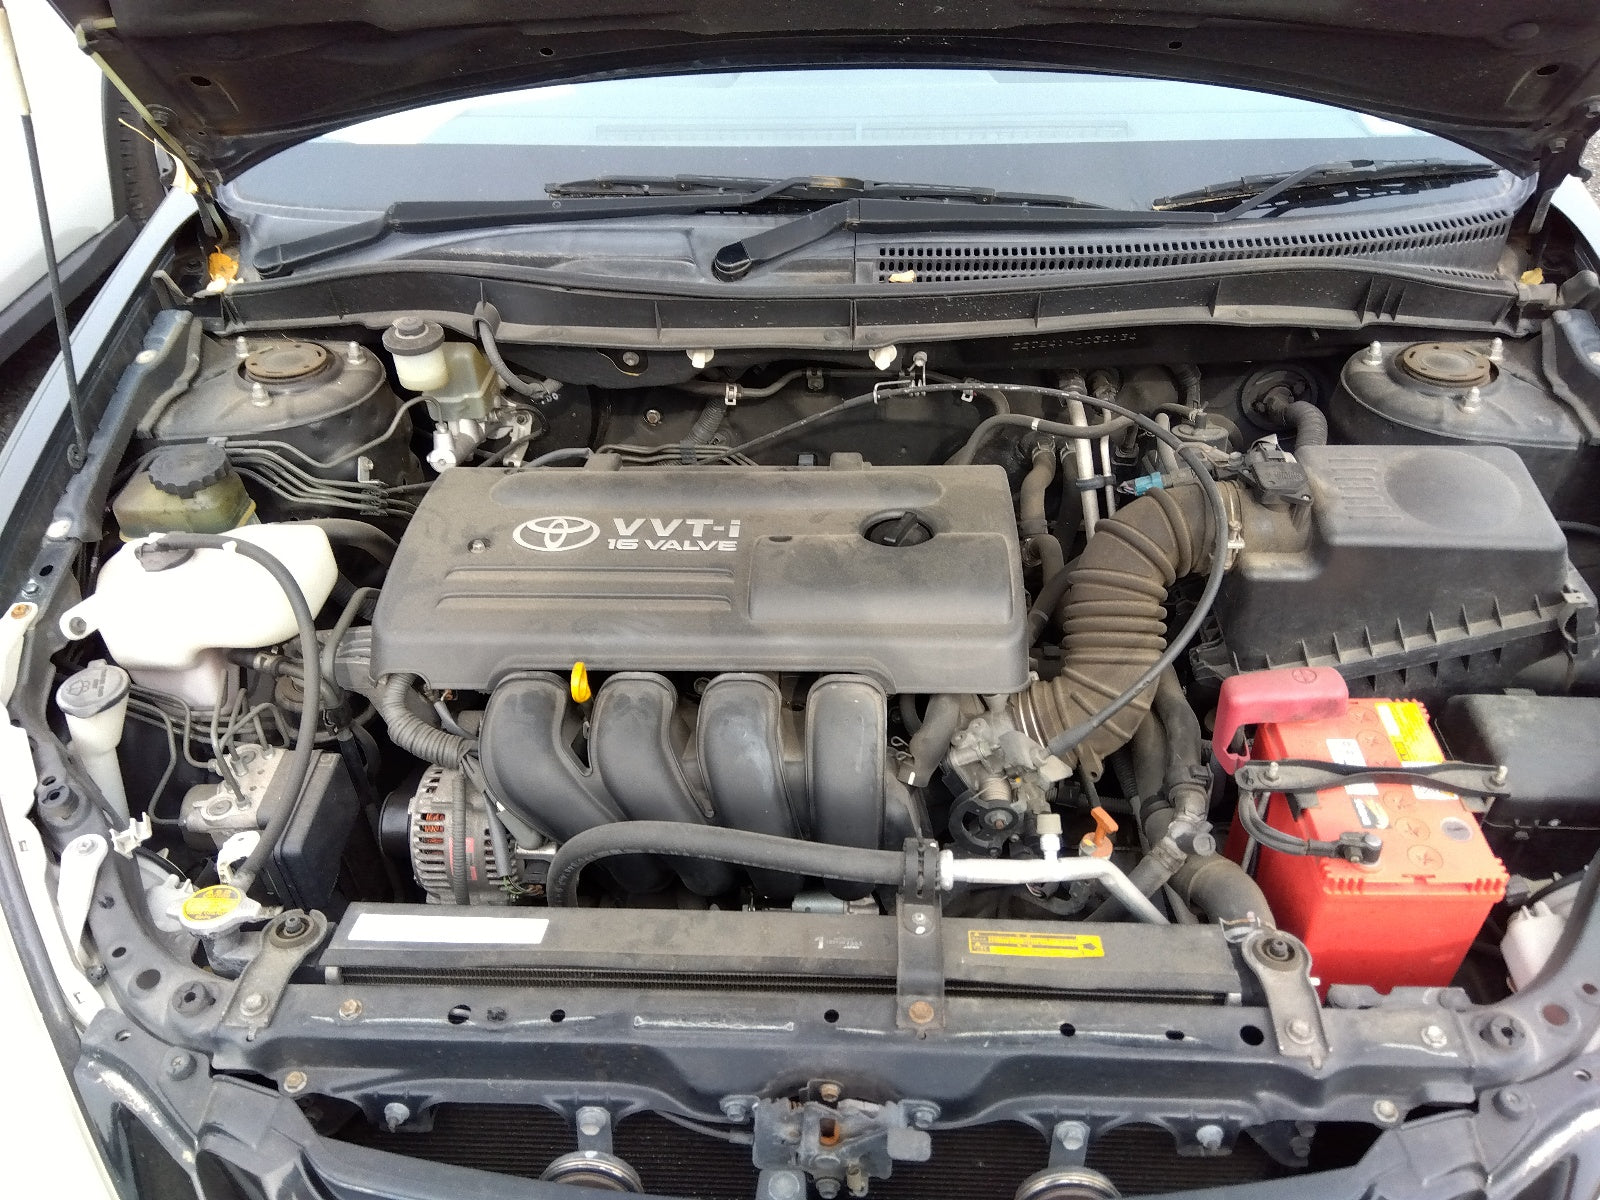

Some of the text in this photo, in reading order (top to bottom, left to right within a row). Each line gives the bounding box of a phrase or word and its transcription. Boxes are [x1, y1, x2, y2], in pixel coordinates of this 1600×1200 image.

[612, 517, 741, 538] VVT-i
[607, 538, 738, 552] 16 VALVE
